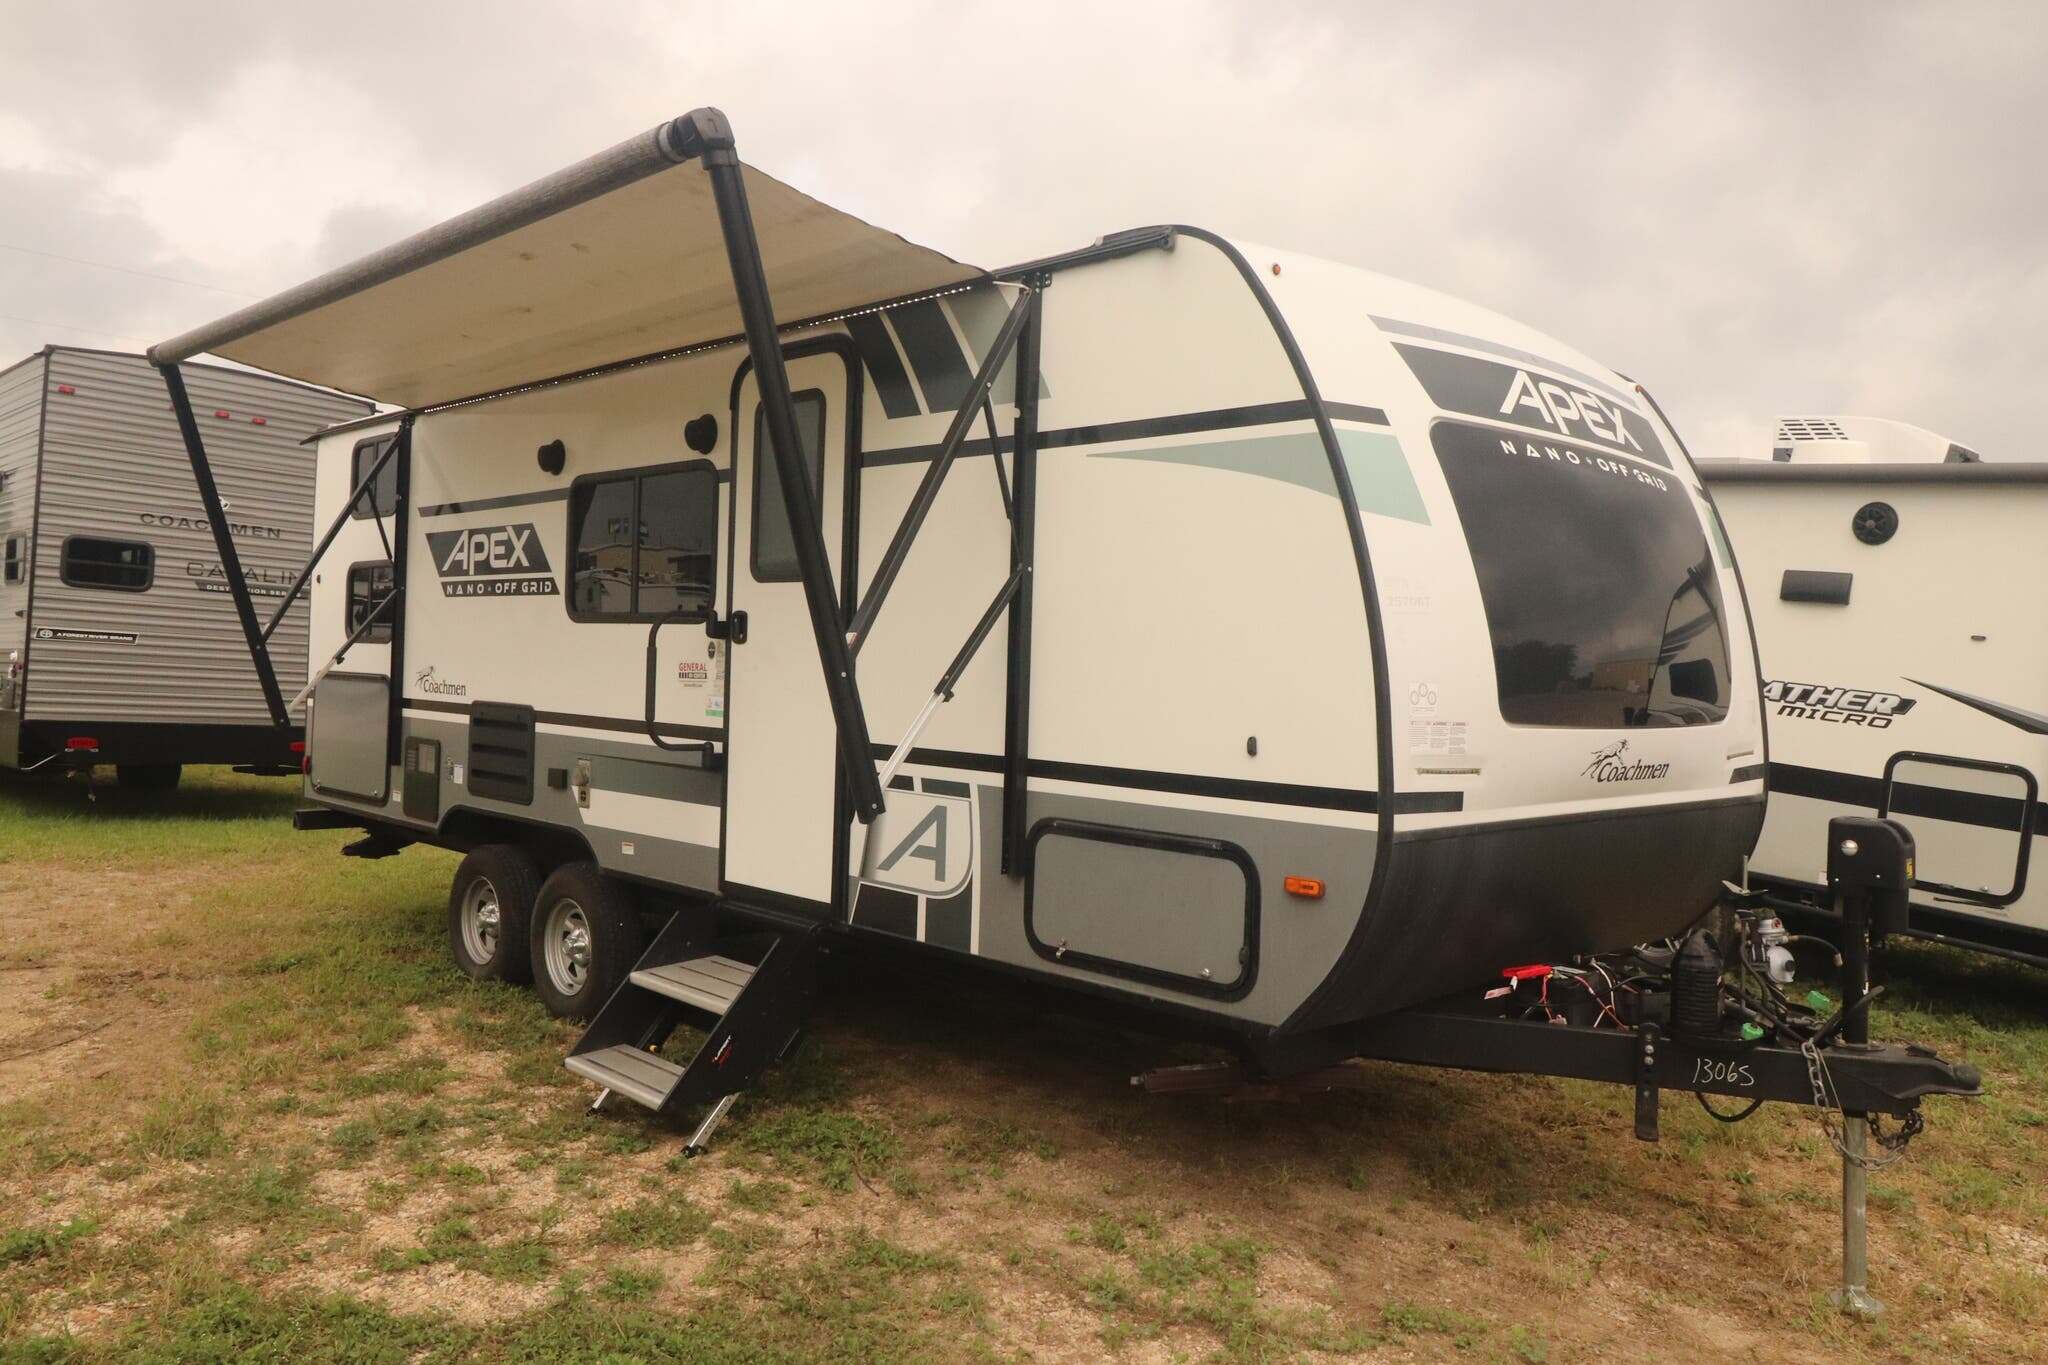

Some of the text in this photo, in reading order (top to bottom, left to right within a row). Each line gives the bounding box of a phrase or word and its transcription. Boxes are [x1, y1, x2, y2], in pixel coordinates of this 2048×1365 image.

[1499, 370, 1643, 452] APEX
[1499, 440, 1667, 492] NANO OFF GRID
[140, 513, 282, 540] COACMEN
[441, 525, 531, 576] APEX
[446, 581, 552, 595] NANO OFF GRID
[678, 662, 707, 672] GENERAL
[423, 679, 466, 696] Coachmen
[1763, 681, 1902, 716] ATHER
[1777, 705, 1892, 729] MICRO
[1597, 758, 1669, 783] Coachmen
[876, 805, 947, 882] A
